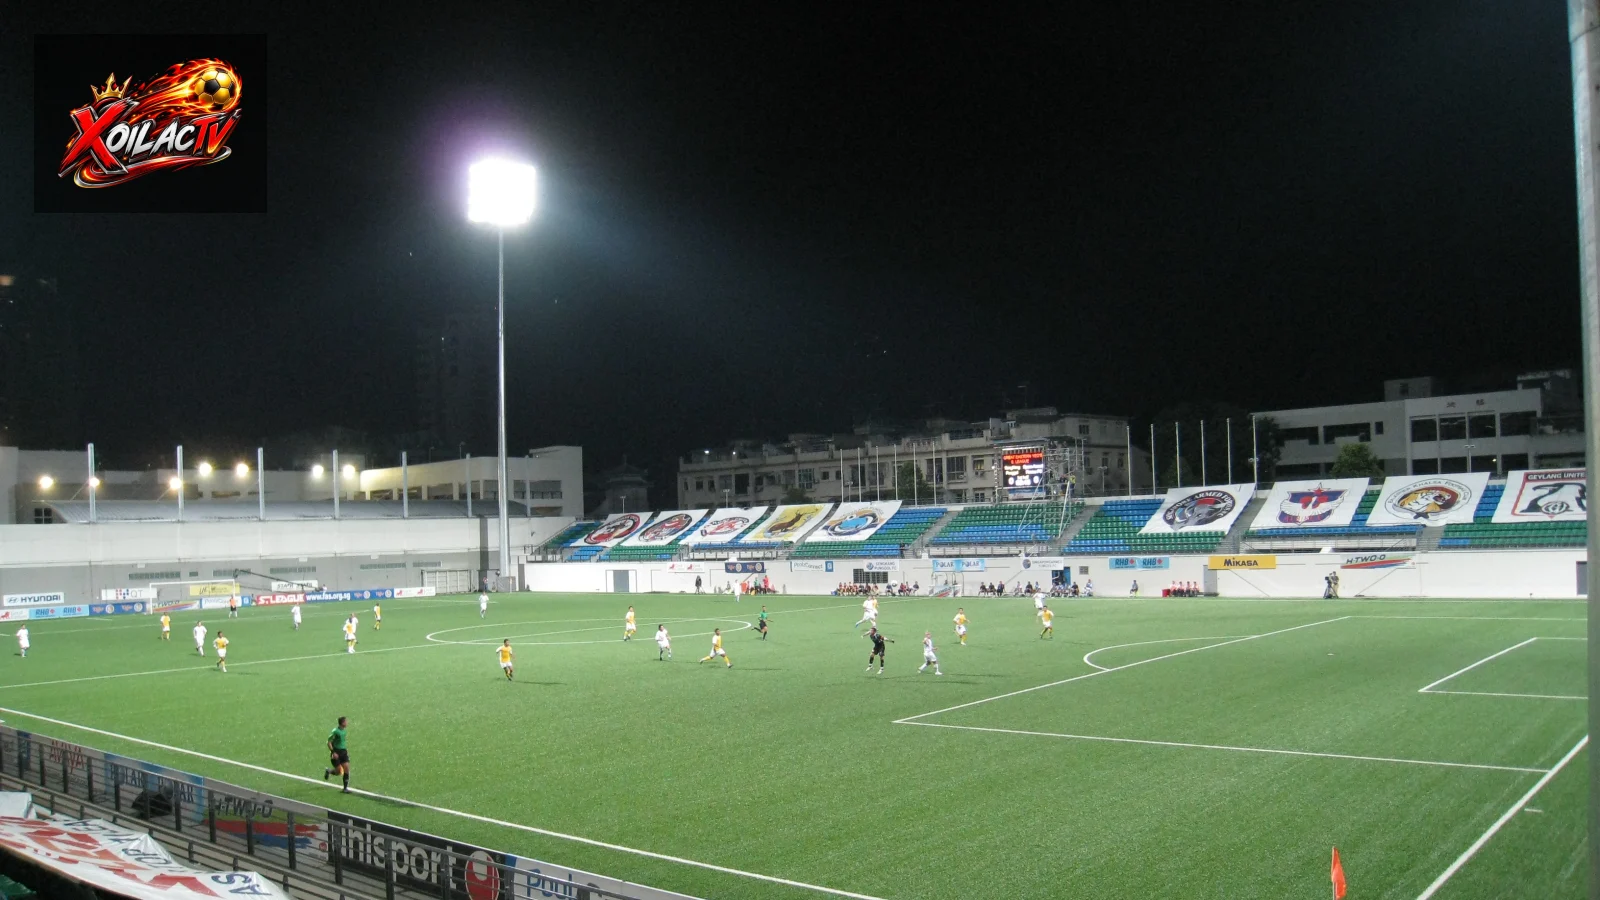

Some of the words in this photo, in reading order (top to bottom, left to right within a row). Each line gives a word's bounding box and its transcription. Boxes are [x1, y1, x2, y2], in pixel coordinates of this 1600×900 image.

[1194, 491, 1223, 500] ARMED
[1115, 558, 1129, 566] RHB
[1142, 558, 1157, 566] RHB
[1223, 557, 1259, 567] MIKASA
[20, 594, 62, 603] HYUNDAI
[306, 592, 351, 601] www.fas.org.sg
[36, 608, 50, 616] RHB
[63, 606, 77, 614] RHB
[110, 763, 143, 788] PLAR
